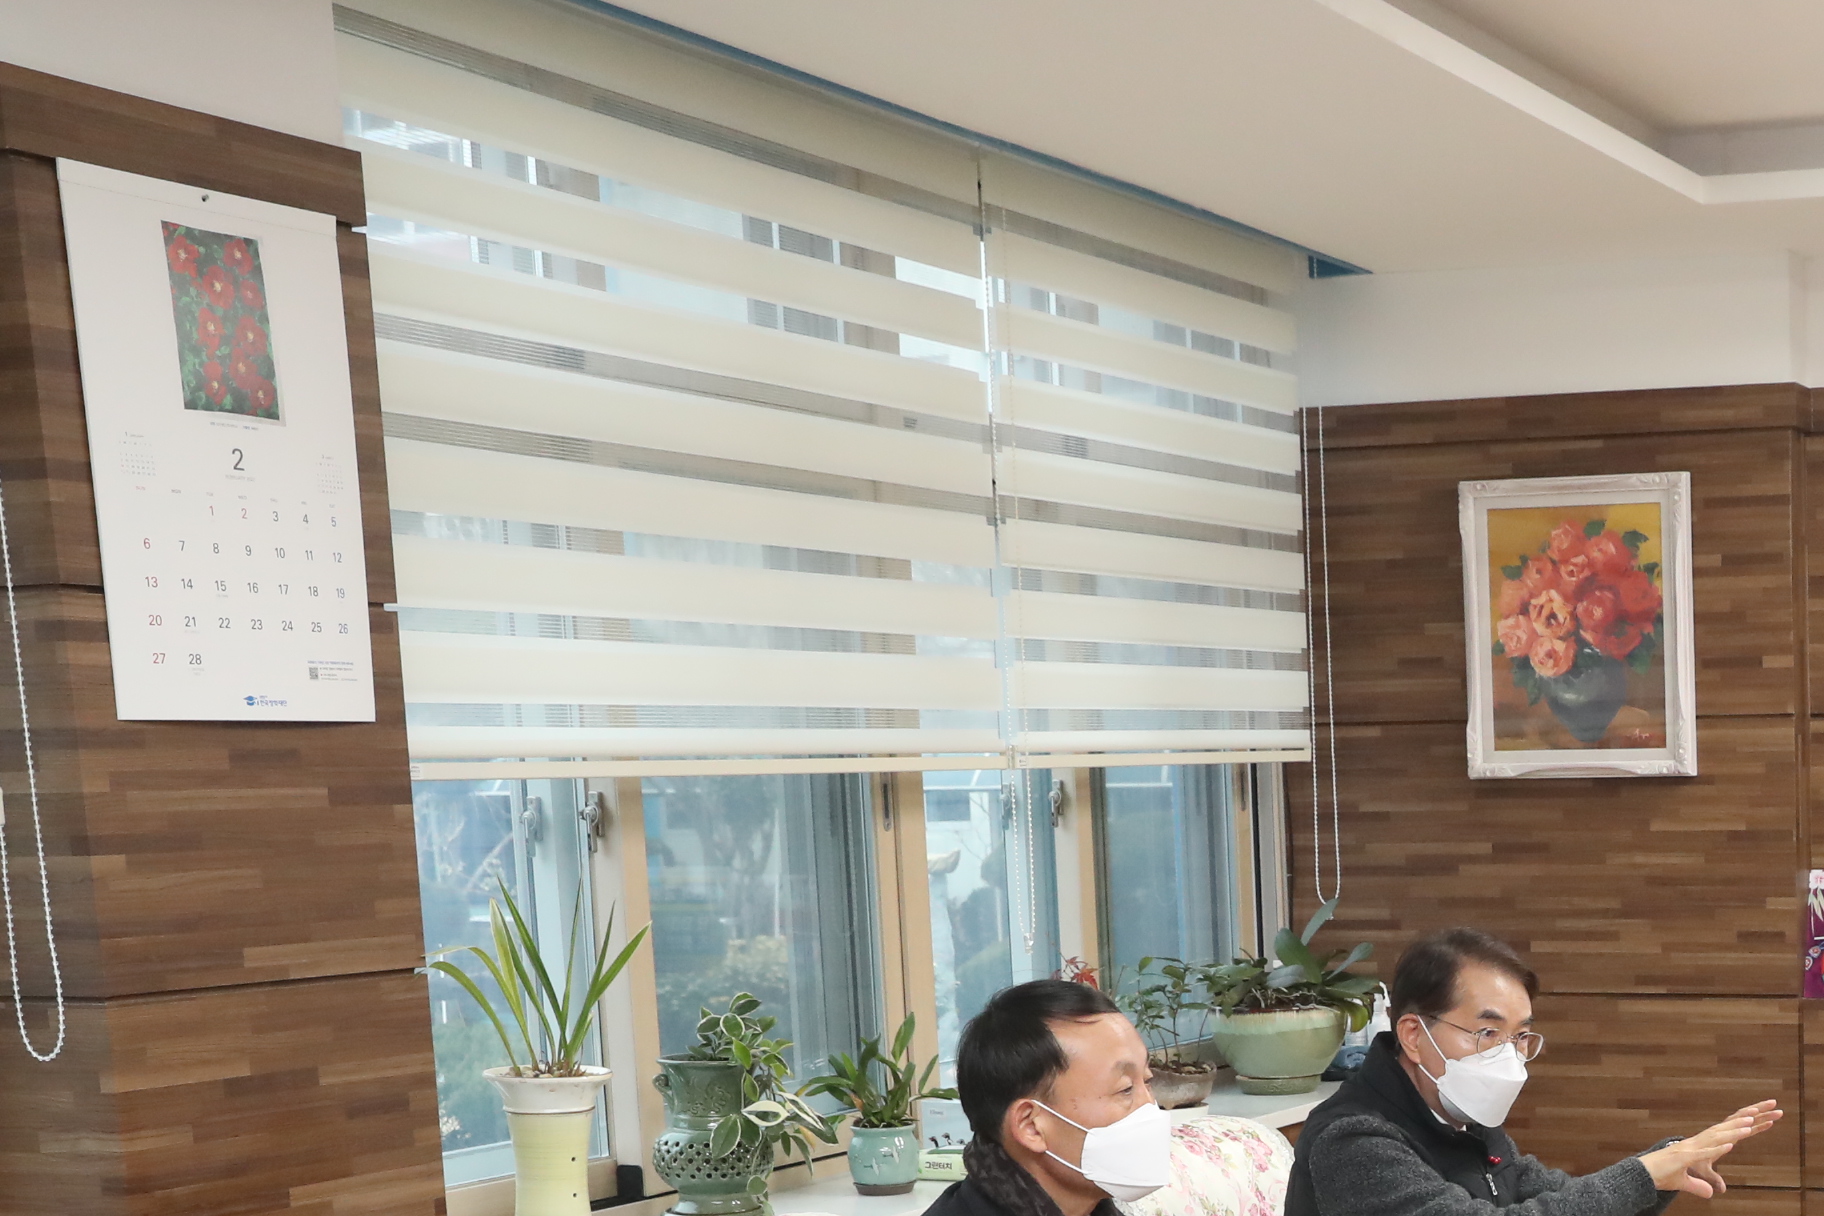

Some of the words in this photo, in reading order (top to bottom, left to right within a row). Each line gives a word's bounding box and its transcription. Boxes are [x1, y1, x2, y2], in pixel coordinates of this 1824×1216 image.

[232, 448, 244, 471] 2
[210, 506, 214, 516] 1
[241, 508, 247, 519] 2
[273, 511, 278, 522] 3
[303, 514, 308, 524] 4
[331, 517, 336, 527] 5
[144, 538, 150, 549] 6
[179, 540, 184, 551] 7
[213, 543, 219, 554] 8
[245, 545, 251, 556] 9
[275, 548, 285, 558] 10
[305, 550, 313, 560] 11
[333, 552, 342, 563] 12
[145, 576, 158, 588] 13
[182, 579, 193, 589] 14
[215, 580, 226, 591] 15
[248, 582, 258, 593] 16
[278, 584, 288, 594] 17
[308, 586, 318, 596] 18
[336, 588, 345, 598] 19
[149, 615, 162, 626] 20
[185, 616, 196, 627] 21
[219, 618, 230, 628] 22
[251, 619, 262, 630] 23
[282, 621, 293, 631] 24
[312, 622, 322, 632] 25
[339, 624, 348, 634] 26
[153, 653, 165, 664] 27
[189, 654, 202, 665] 28
